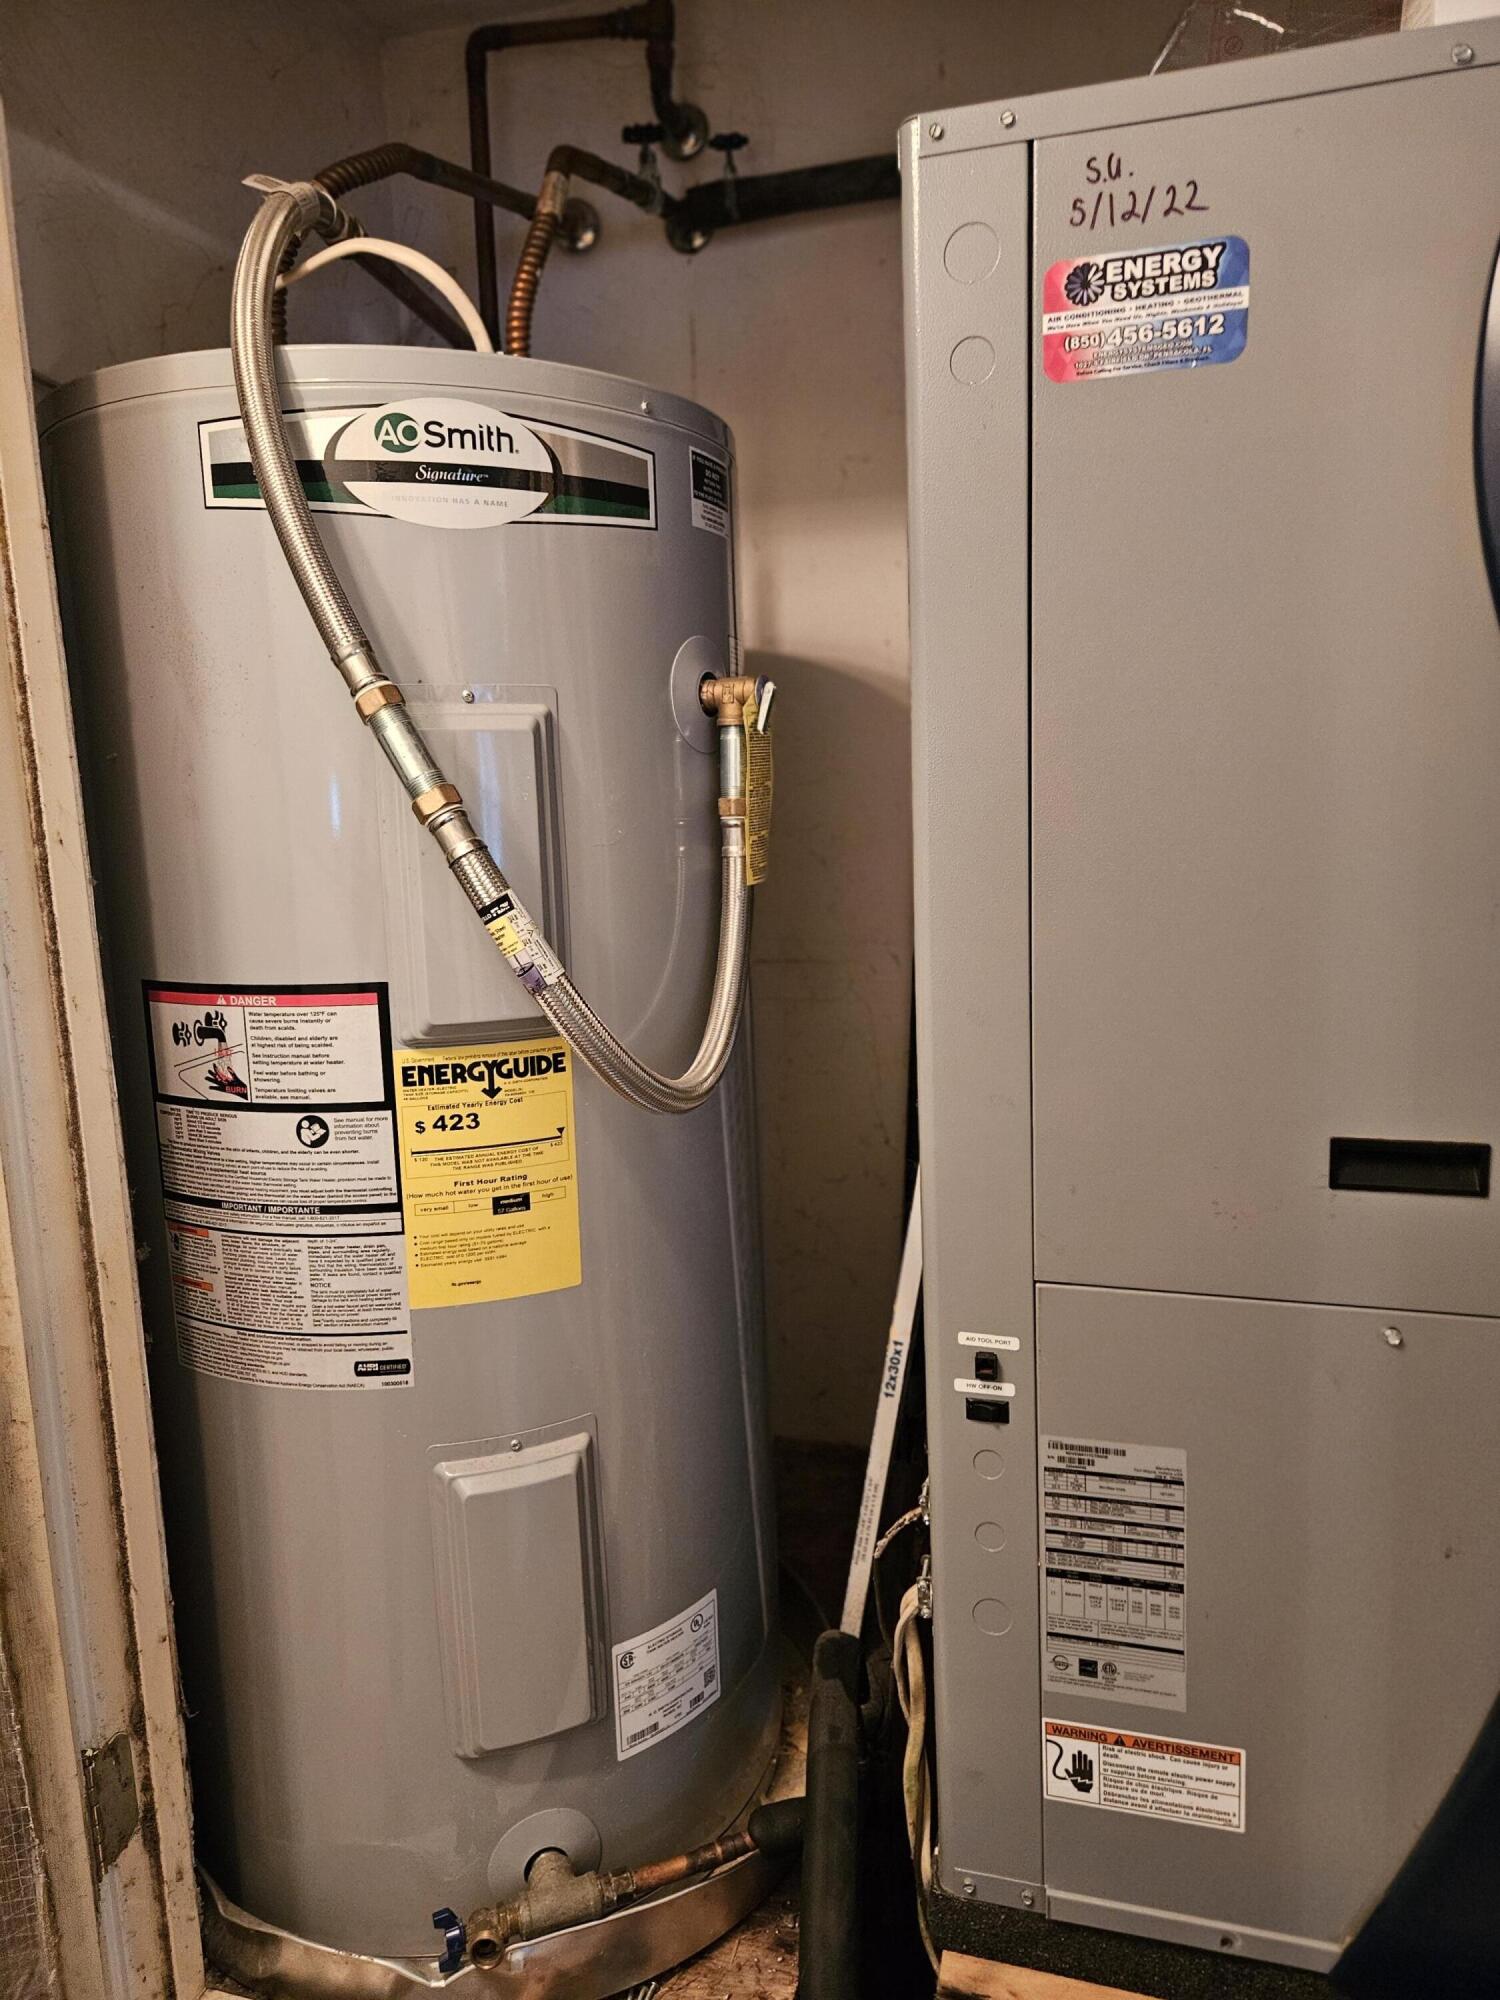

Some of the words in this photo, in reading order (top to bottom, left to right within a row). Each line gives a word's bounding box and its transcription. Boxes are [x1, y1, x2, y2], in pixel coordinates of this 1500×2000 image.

[1069, 179, 1210, 231] 5/12/22
[1105, 244, 1225, 284] ENERGY
[1113, 269, 1216, 300] SYSTEMS
[1064, 308, 1126, 320] CONDITIONING
[1135, 300, 1174, 310] HEATING
[1184, 291, 1242, 304] GEOTHERMAL
[452, 497, 470, 505] HAS
[483, 499, 509, 508] NAME
[229, 995, 277, 1006] DANGER
[402, 1052, 566, 1088] ENERGYGUIDE
[225, 1086, 248, 1094] BURN
[428, 1103, 460, 1111] Estimated
[415, 1121, 426, 1135] $
[432, 1113, 480, 1132] 423
[500, 1174, 528, 1182] Rating
[221, 1202, 262, 1213] IMPORTANT
[268, 1205, 320, 1214] IMPORTANTE
[884, 1340, 904, 1399] 12x30x1
[1052, 1725, 1108, 1742] WARNING
[1132, 1739, 1235, 1763] AVERTISSEMENT
[1124, 1748, 1146, 1758] electric
[1202, 1762, 1219, 1770] injury
[1103, 1761, 1135, 1770] Disconnect
[1148, 1768, 1169, 1776] remote
[1171, 1770, 1193, 1780] electric
[1216, 1780, 1236, 1788] supply
